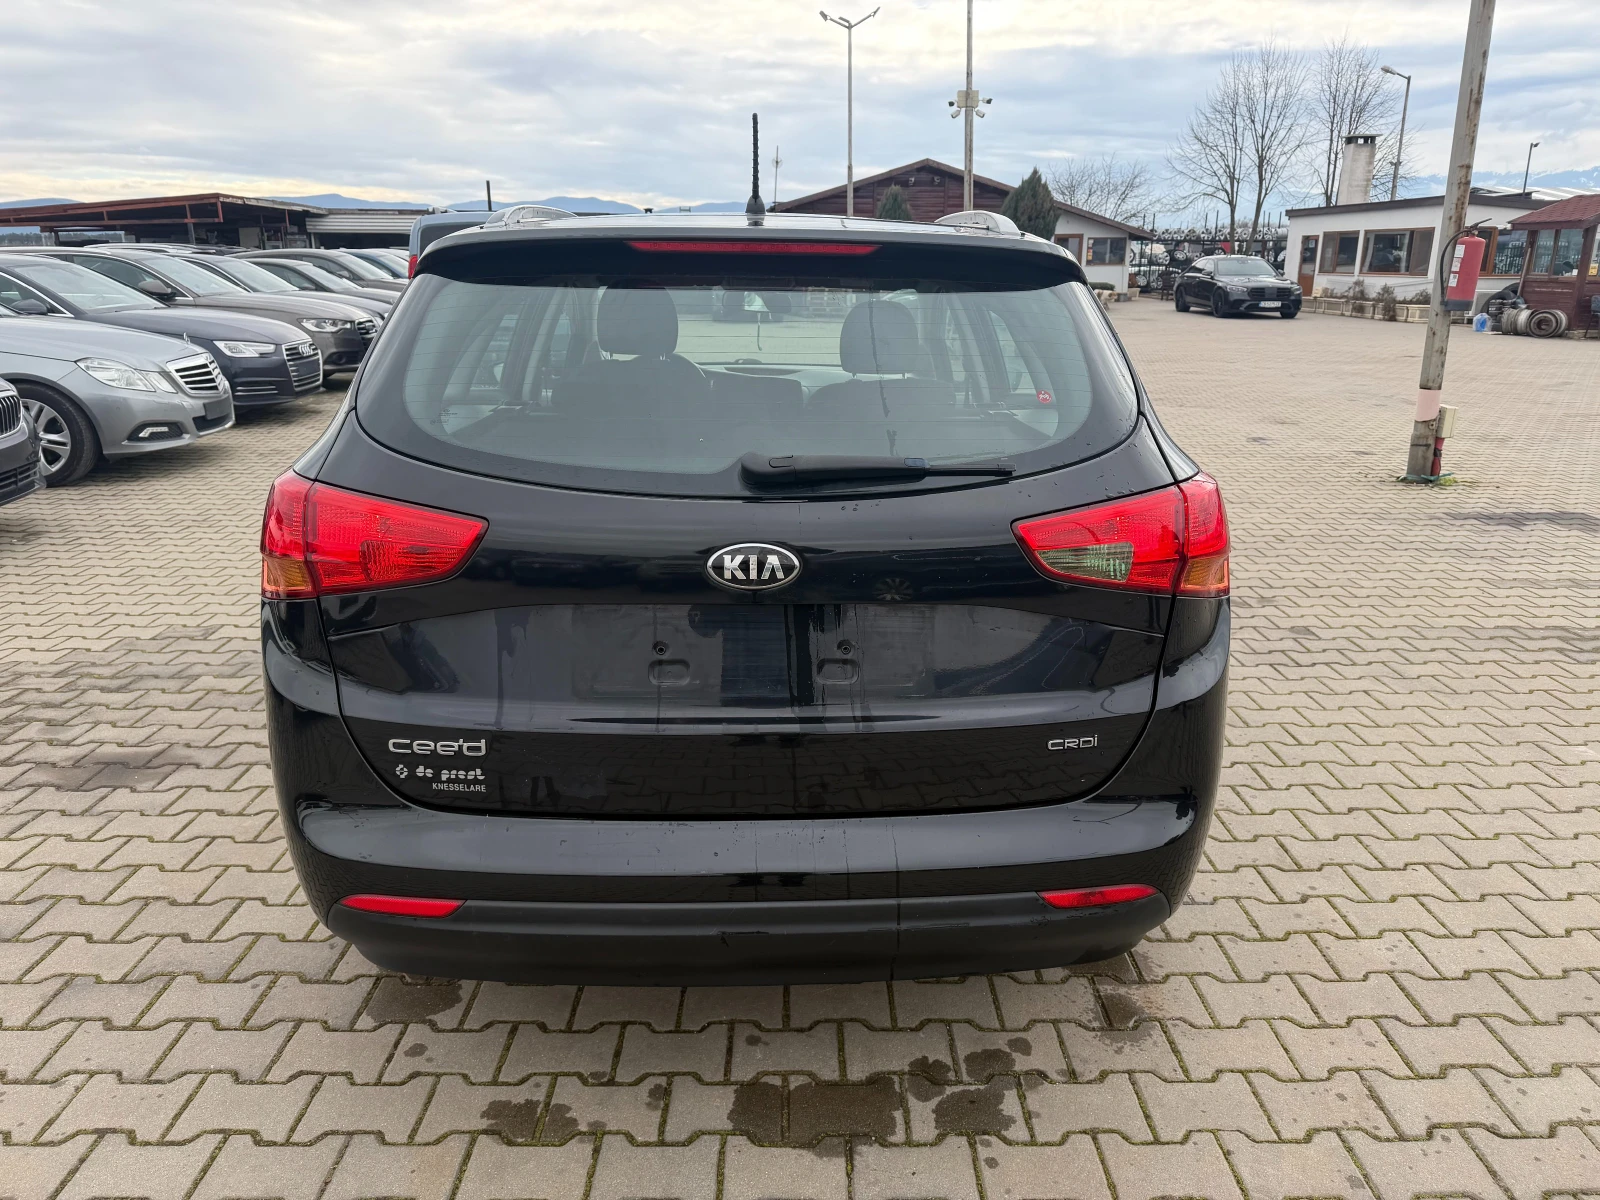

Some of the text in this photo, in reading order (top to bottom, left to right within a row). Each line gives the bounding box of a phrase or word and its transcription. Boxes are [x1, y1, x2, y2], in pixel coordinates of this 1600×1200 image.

[723, 554, 785, 580] KIA
[415, 765, 434, 778] de
[432, 782, 487, 793] KNESSELARE
